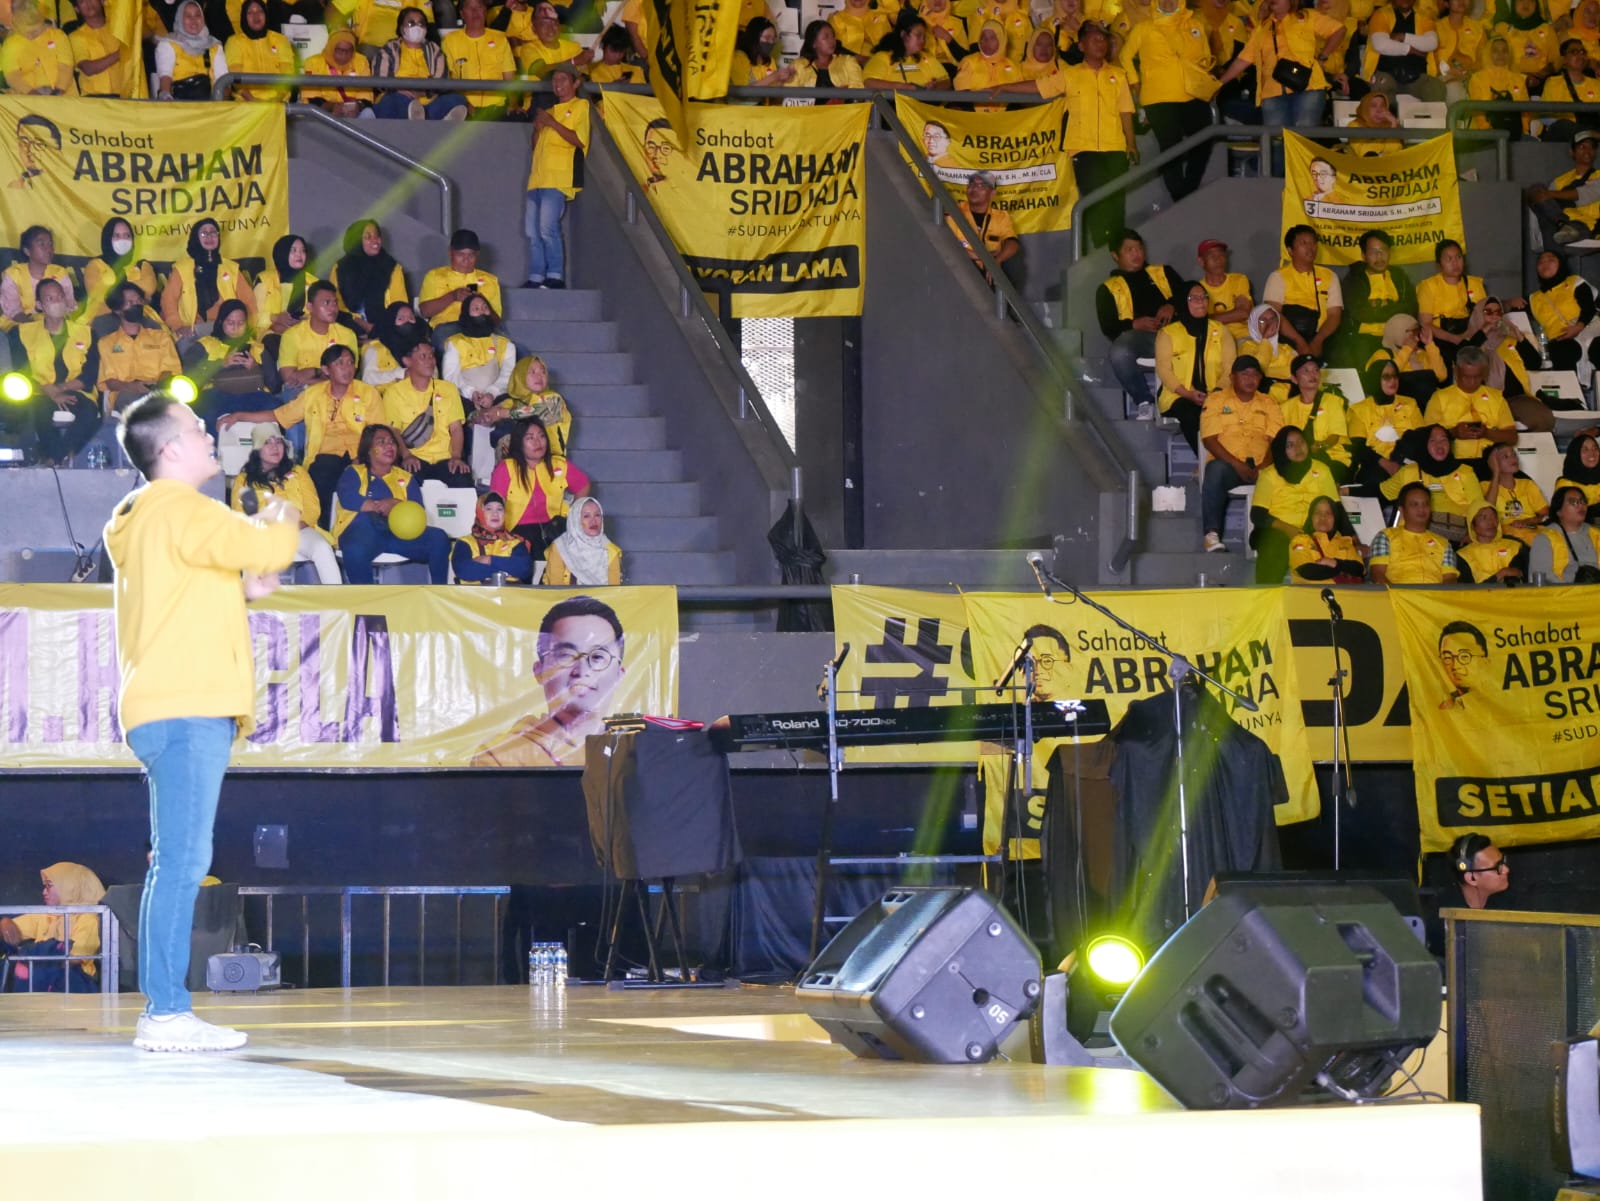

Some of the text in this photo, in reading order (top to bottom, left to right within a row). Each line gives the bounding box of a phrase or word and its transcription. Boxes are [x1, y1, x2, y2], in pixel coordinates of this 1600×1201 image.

[69, 127, 155, 150] Sahabat
[696, 128, 774, 149] Sahabat
[961, 129, 1057, 150] ABRAHAM
[73, 144, 263, 184] ABRAHAM
[696, 142, 860, 185] ABRAHAM
[1347, 163, 1441, 186] ABRAHAM
[111, 181, 267, 215] SRIDJAJA
[729, 178, 859, 216] SRIDJAJA
[1366, 178, 1439, 200] SRIDJAJA
[1306, 202, 1317, 215] 3
[780, 257, 848, 282] LAMA
[1077, 629, 1169, 651] Sahabat
[1494, 622, 1582, 649] Sahabat
[246, 612, 400, 744] CLA
[772, 717, 820, 730] Roland
[988, 1004, 1009, 1025] 05
